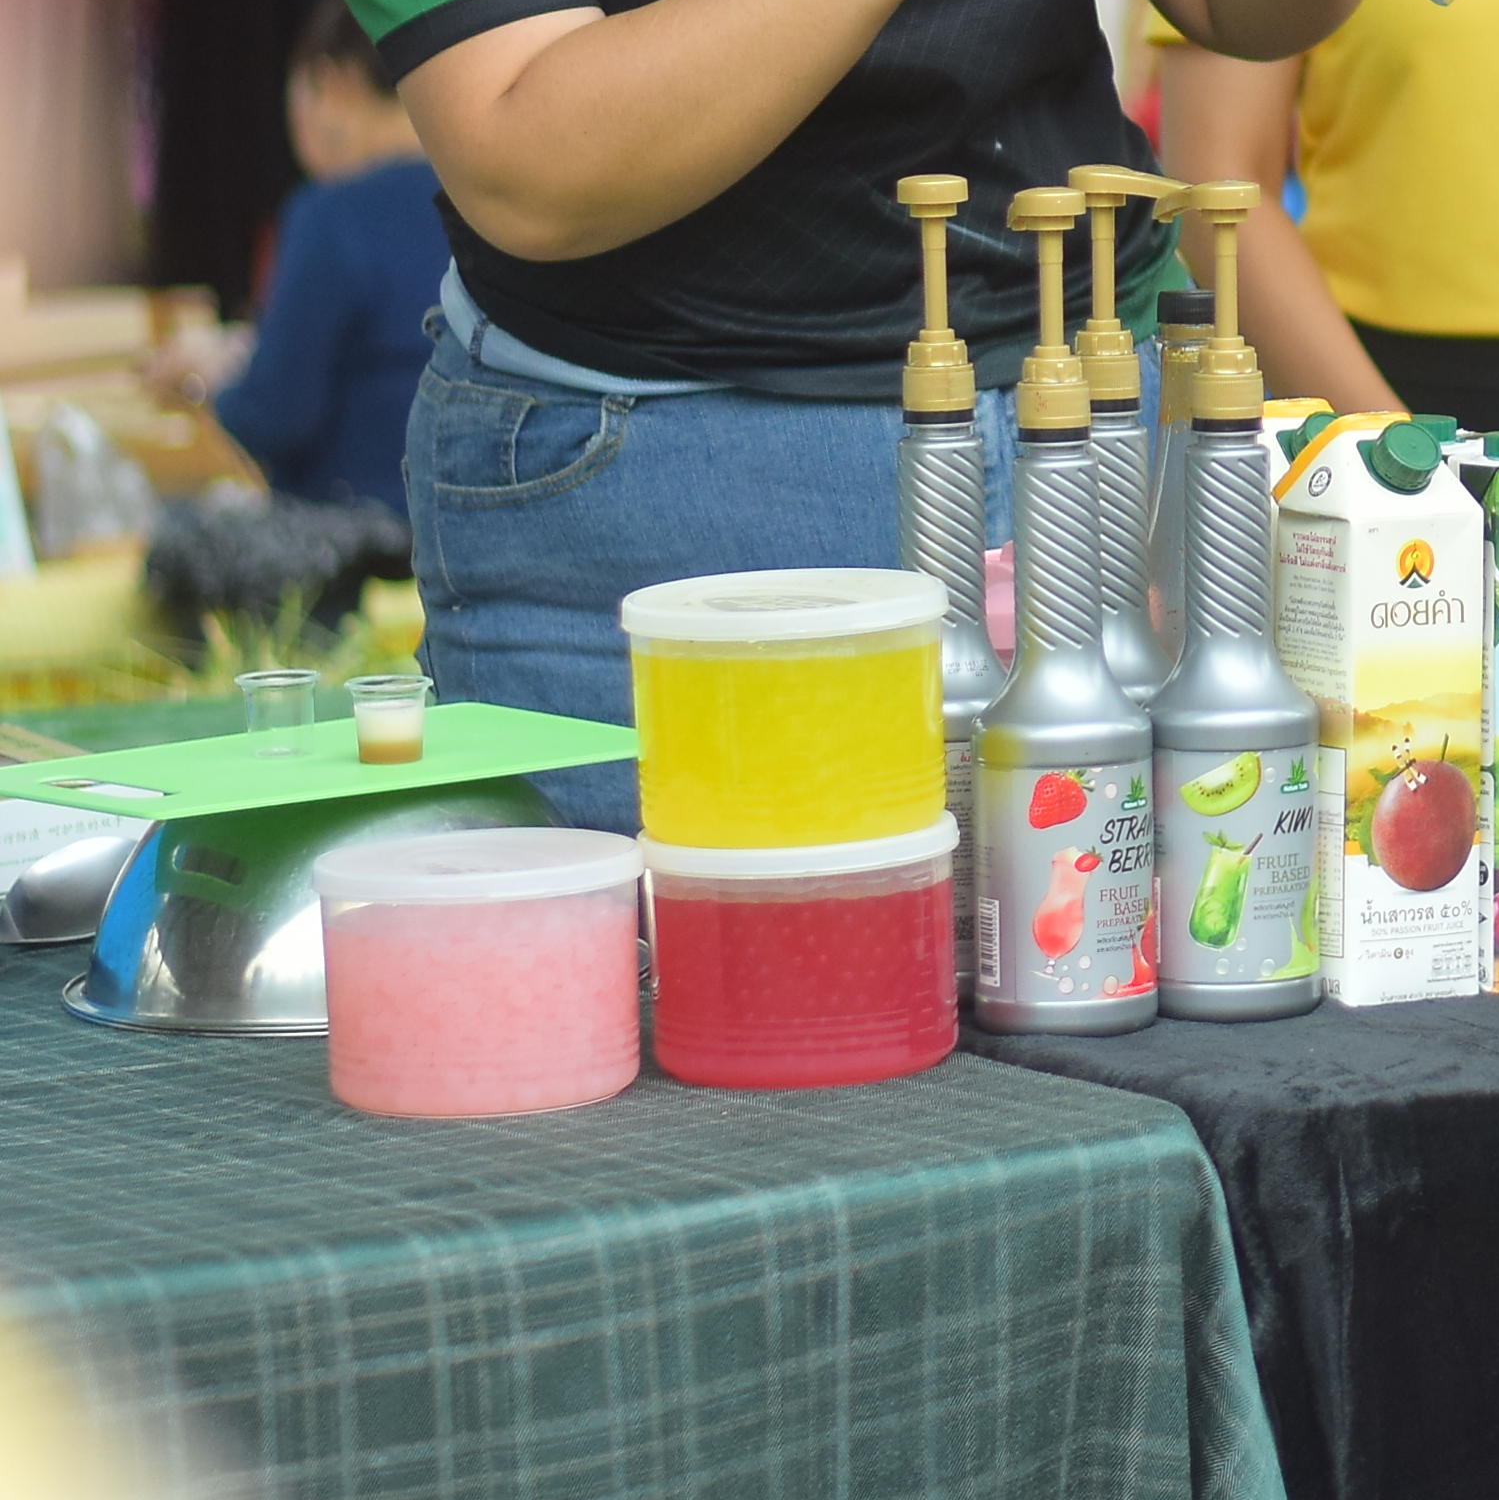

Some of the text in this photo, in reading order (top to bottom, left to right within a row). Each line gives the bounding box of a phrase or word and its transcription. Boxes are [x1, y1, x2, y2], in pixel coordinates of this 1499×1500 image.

[1370, 591, 1465, 629] ดอยคำ
[1257, 853, 1300, 870] FRUIT
[1271, 866, 1311, 883] BASED
[1100, 885, 1139, 902] FRUIT
[1114, 897, 1149, 915] BASED
[1360, 899, 1472, 924] น้ำเสาวรส ๕๐%
[1390, 925, 1421, 934] PASSION
[1423, 922, 1443, 932] FRUIT
[1446, 920, 1464, 929] JUICE
